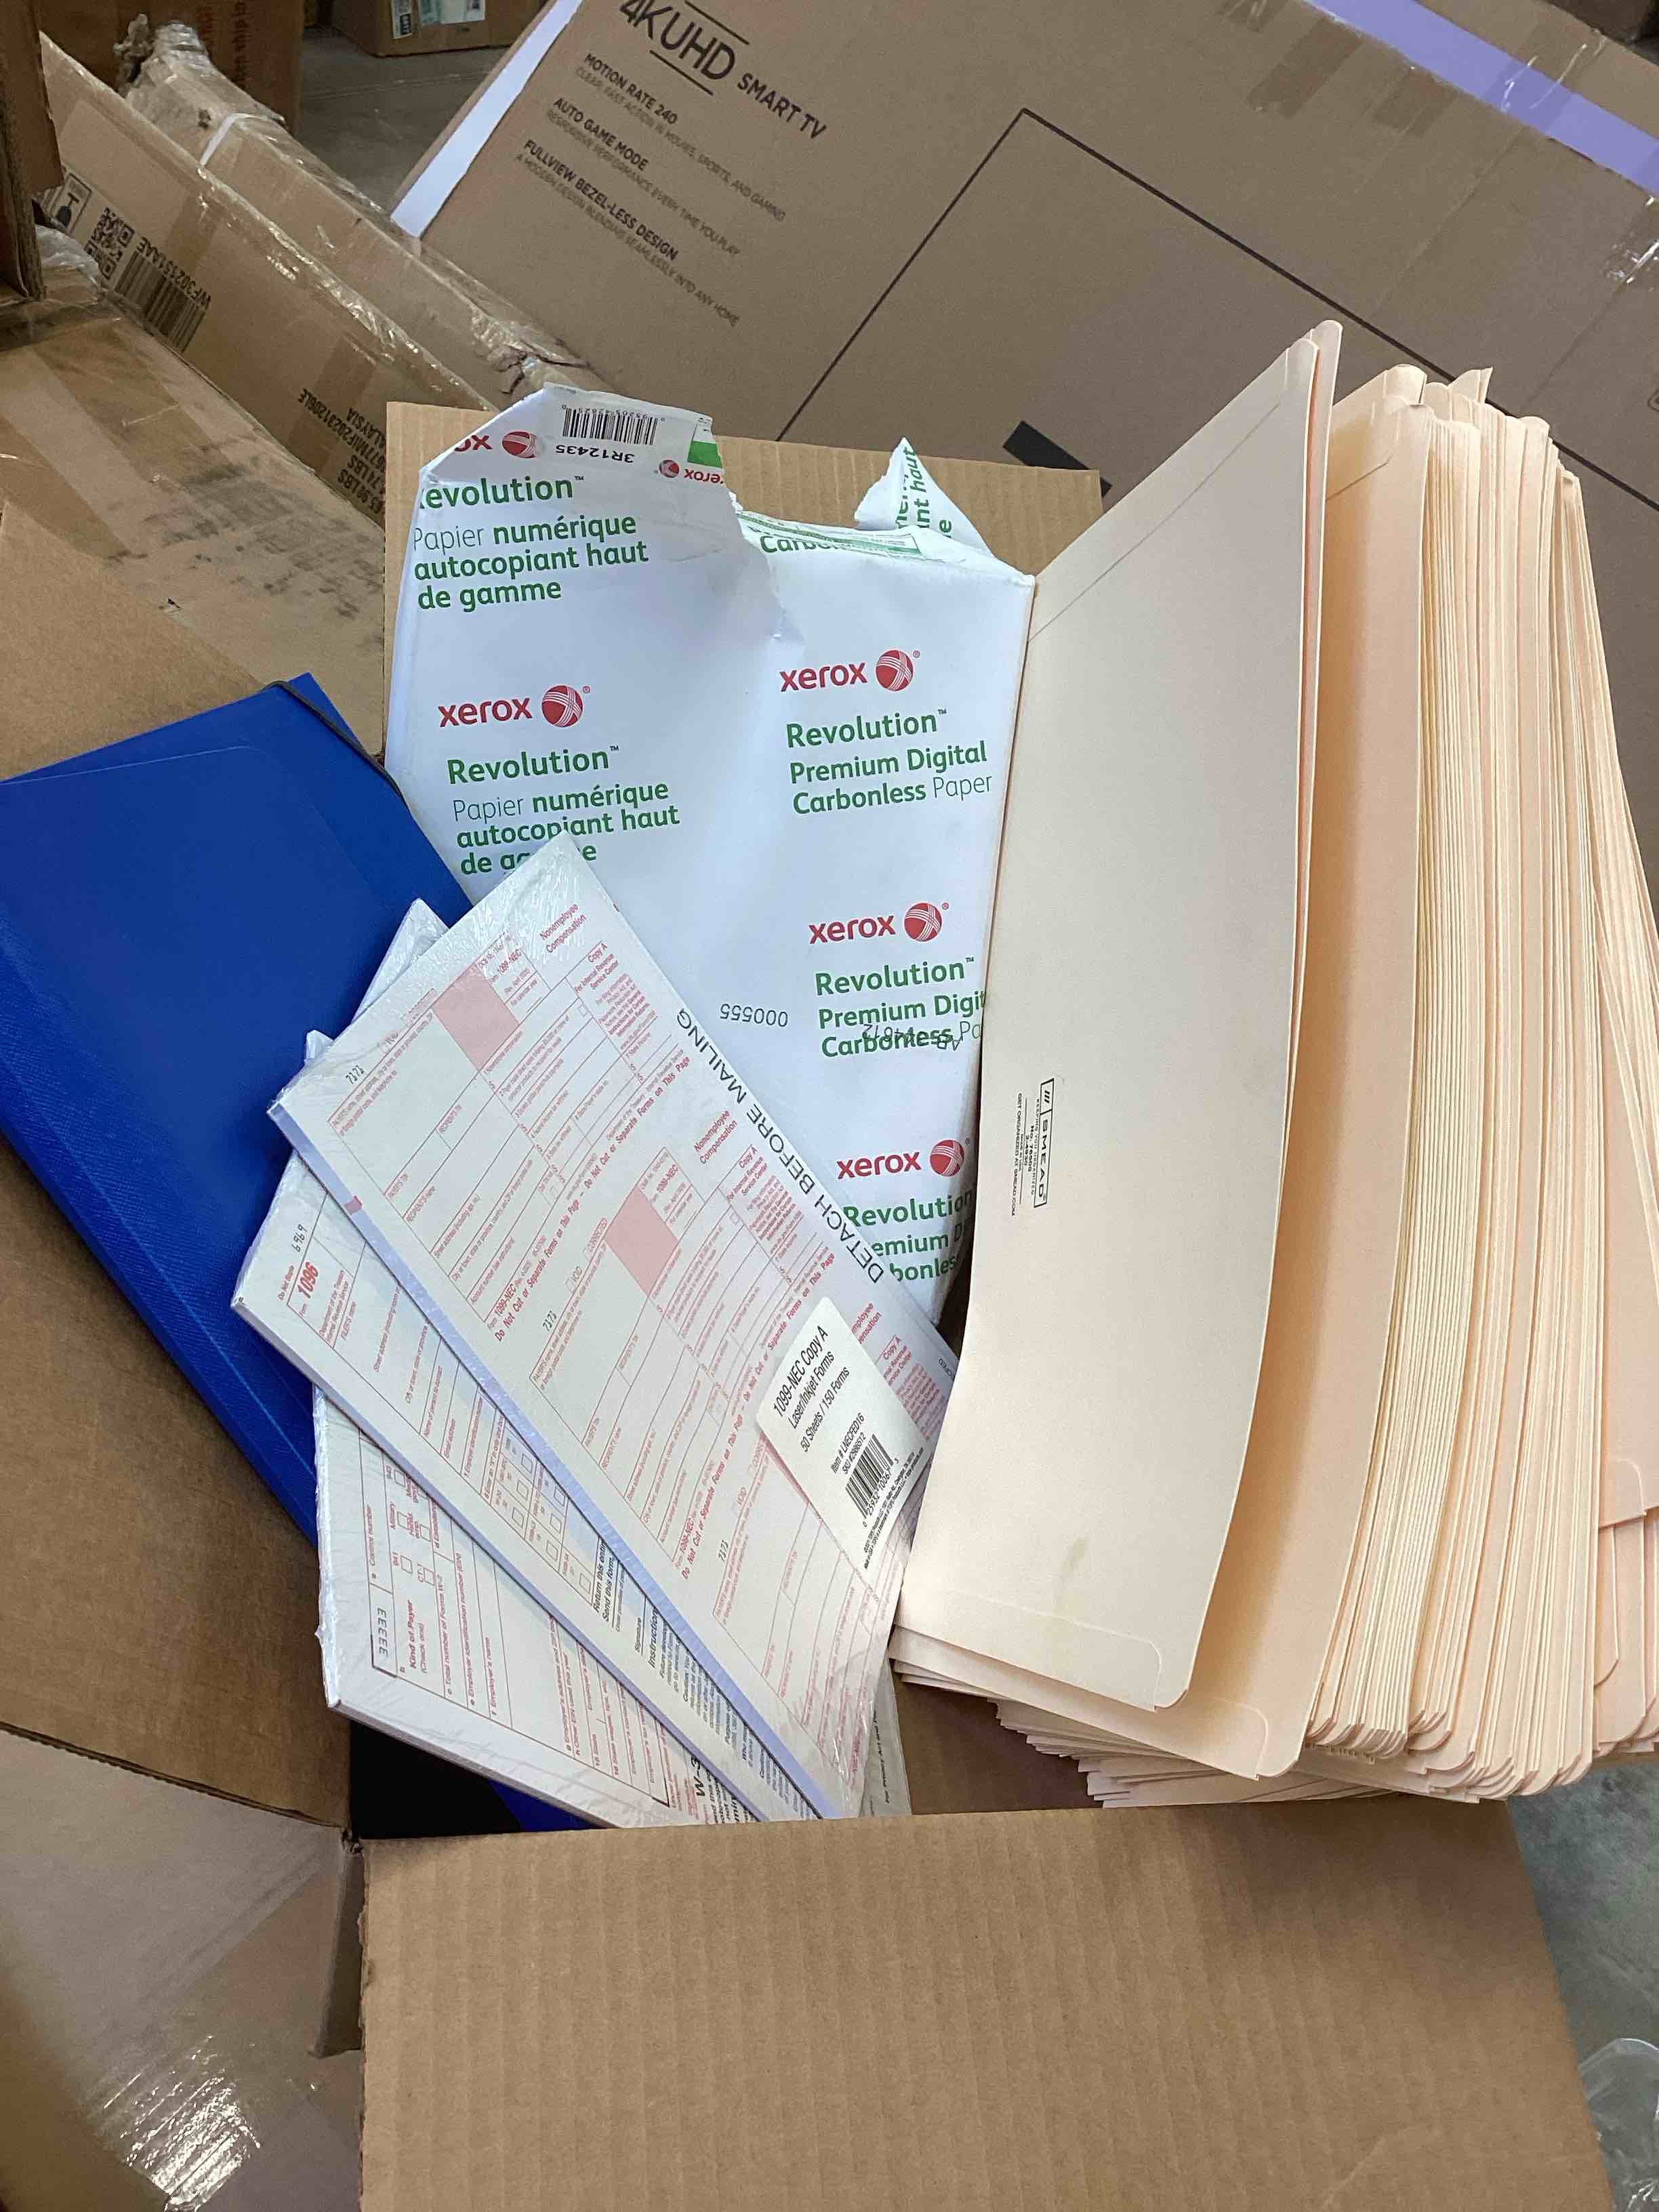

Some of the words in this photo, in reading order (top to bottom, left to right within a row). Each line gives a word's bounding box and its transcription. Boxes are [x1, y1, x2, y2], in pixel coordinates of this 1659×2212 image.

[584, 54, 628, 91] MOTION
[626, 81, 657, 110] RATE
[655, 104, 678, 125] 240
[737, 73, 802, 123] SMART
[802, 112, 827, 140] TV
[553, 98, 585, 122] AUTO
[583, 118, 623, 147] GAME
[614, 143, 650, 171] MODE
[521, 138, 579, 184] FULLVIEW
[571, 176, 640, 230] BEZEL-LESS
[633, 223, 680, 261] DESIGN
[729, 178, 753, 198] AND
[697, 222, 722, 243] YOU
[341, 407, 390, 449] ALAYSIA
[344, 453, 371, 479] LBS
[555, 445, 634, 464] 3R12435
[333, 468, 362, 494] LBS
[684, 468, 724, 484] erox
[413, 527, 485, 554] Papier
[493, 515, 637, 545] numérique
[414, 547, 580, 581] autocopiant
[586, 541, 650, 568] haut
[417, 585, 451, 610] de
[459, 581, 562, 613] gamme
[780, 661, 867, 693] xerox
[438, 697, 533, 728] xerox
[790, 756, 900, 784] Premium
[907, 740, 988, 773] Digital
[453, 795, 525, 823] Papier
[532, 783, 669, 814] numérique
[793, 783, 926, 815] Carbonless
[933, 774, 993, 801] Paper
[456, 811, 614, 848] autocopiant
[621, 805, 680, 831] haut
[460, 852, 493, 875] de
[496, 945, 523, 977] 1099-NEC
[539, 903, 579, 940] Nonemployee
[545, 914, 588, 954] Compensation
[809, 914, 896, 944] xerox
[586, 945, 603, 966] Copy
[599, 939, 609, 951] A
[581, 966, 598, 988] Internal
[594, 949, 615, 975] Revenue
[589, 970, 607, 992] Service
[604, 957, 619, 977] Center
[719, 1002, 788, 1027] 000555
[818, 1002, 930, 1029] Premium
[934, 990, 986, 1017] Digit
[672, 1053, 695, 1076] Page
[676, 1008, 747, 1104] MAILING
[651, 1084, 665, 1097] on
[659, 1069, 678, 1088] This
[636, 1095, 654, 1118] Forms
[611, 1117, 638, 1146] Separate
[699, 1120, 737, 1165] Compensation
[595, 1149, 613, 1167] Cut
[607, 1142, 619, 1155] or
[656, 1164, 678, 1193] 1099-NEC
[694, 1109, 731, 1153] Nonemployee
[738, 1151, 752, 1169] Copy
[750, 1146, 758, 1155] A
[746, 1103, 816, 1195] BEFORE
[1014, 1157, 1018, 1167] AT
[1038, 1118, 1048, 1198] SMEAD
[587, 1162, 604, 1179] Not
[836, 1149, 922, 1180] xerox
[580, 1174, 596, 1190] Do
[558, 1214, 575, 1231] This
[564, 1197, 581, 1217] Page
[291, 1224, 307, 1253] 6969
[543, 1239, 559, 1259] Forms
[554, 1228, 566, 1240] on
[814, 1193, 885, 1284] DETACH
[870, 1233, 949, 1256] emium
[296, 1261, 319, 1300] 1096
[519, 1286, 531, 1298] or
[525, 1262, 547, 1291] Separate
[495, 1283, 517, 1316] 1099-NEC
[509, 1295, 527, 1313] Cut
[768, 1317, 787, 1351] Separate
[785, 1298, 802, 1320] Forms
[802, 1286, 811, 1297] on
[808, 1267, 822, 1286] This
[821, 1252, 836, 1270] Page
[500, 1311, 518, 1329] Not
[851, 1303, 874, 1334] mployee
[493, 1327, 508, 1342] Do
[883, 1344, 897, 1359] Copy
[773, 1359, 806, 1417] 1099-NEC
[800, 1338, 825, 1368] Copy
[817, 1325, 828, 1343] A
[787, 1374, 818, 1430] Laser/Inkjet
[814, 1351, 835, 1380] Forms
[800, 1436, 810, 1453] 50
[806, 1410, 823, 1441] Sheets
[822, 1389, 836, 1412] 150
[832, 1366, 850, 1392] Forms
[864, 1490, 882, 1516] 25932
[877, 1467, 893, 1492] 10067
[456, 1571, 466, 1604] number
[592, 1584, 605, 1613] Return
[605, 1578, 614, 1599] this
[405, 1597, 416, 1631] Payer
[601, 1600, 611, 1622] Send
[376, 1606, 388, 1659] 33333
[408, 1629, 415, 1643] of
[458, 1601, 472, 1658] identification
[634, 1616, 643, 1652] Signature
[407, 1641, 418, 1671] Kind
[417, 1639, 428, 1675] (Check
[441, 1628, 451, 1666] number
[483, 1635, 492, 1661] name
[444, 1664, 453, 1687] Total
[464, 1655, 476, 1699] Employer
[485, 1659, 498, 1709] Employer's
[691, 1756, 707, 1797] W-3
